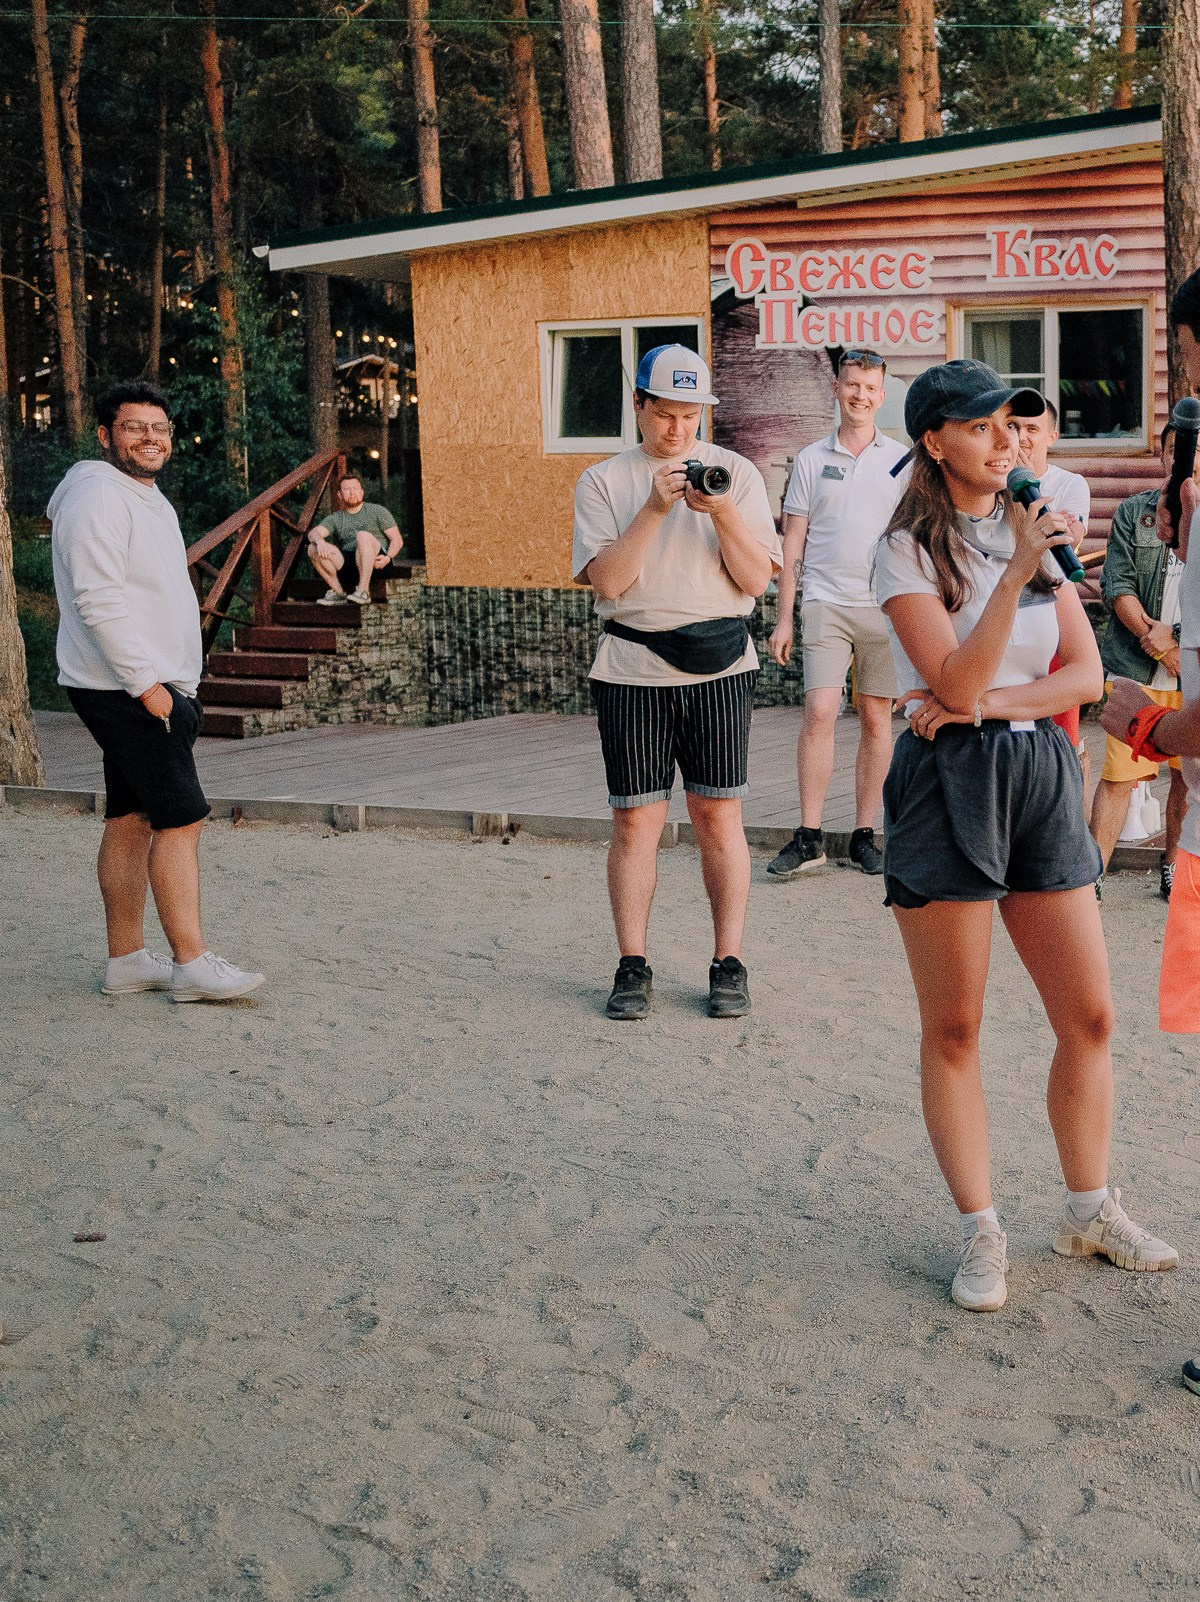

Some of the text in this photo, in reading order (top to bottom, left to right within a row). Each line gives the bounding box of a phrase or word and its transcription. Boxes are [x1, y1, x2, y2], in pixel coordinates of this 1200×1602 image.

[729, 242, 928, 294] Свежее
[991, 228, 1116, 278] Квас
[760, 298, 936, 345] Пенное
